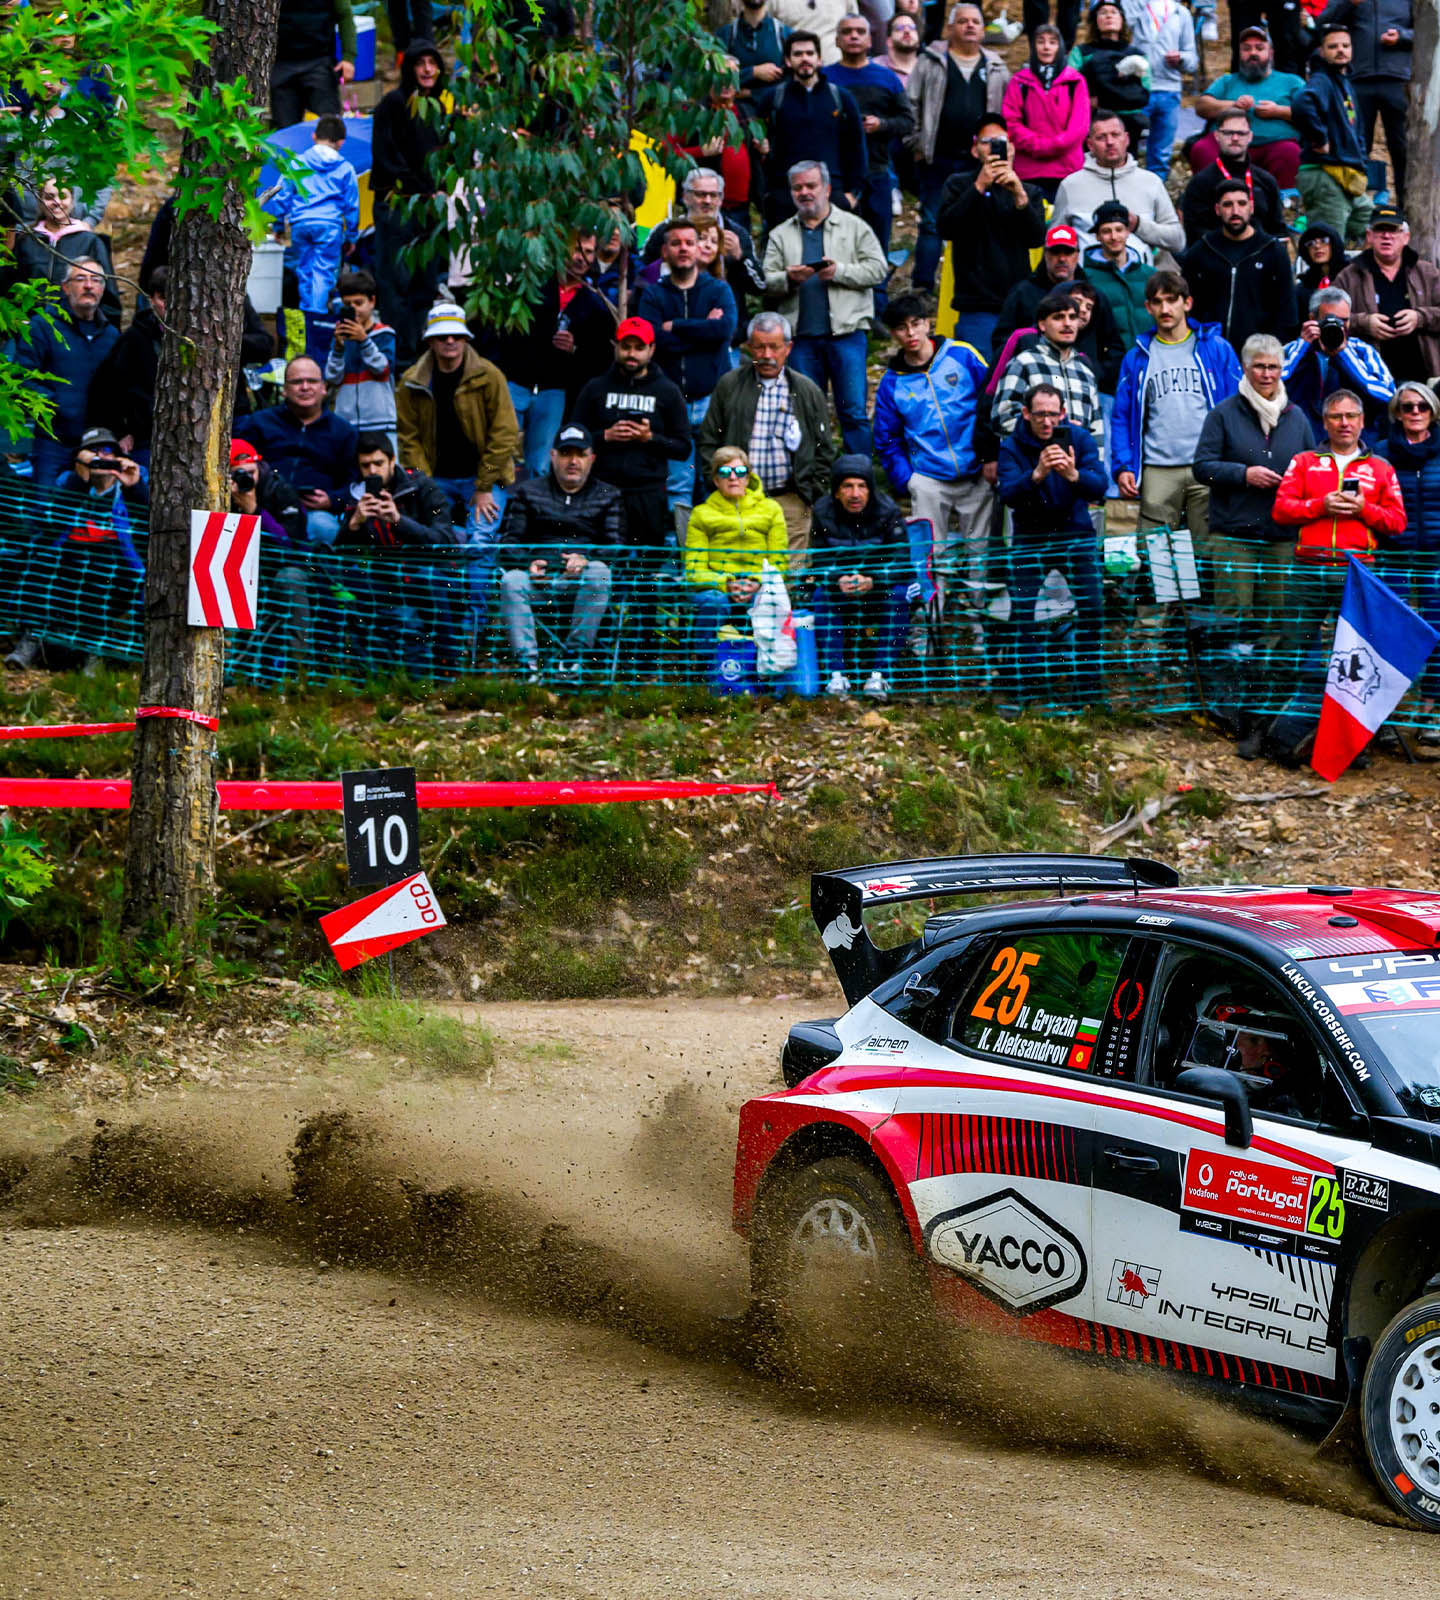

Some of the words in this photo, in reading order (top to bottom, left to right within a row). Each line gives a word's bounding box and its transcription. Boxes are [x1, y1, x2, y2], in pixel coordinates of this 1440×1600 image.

[605, 392, 657, 413] PUMA
[1147, 367, 1201, 404] DICKIE
[358, 814, 409, 867] 10
[971, 946, 1041, 1026] 25
[1015, 1006, 1028, 1030] N.
[1032, 1009, 1078, 1038] Gryazin
[1280, 962, 1372, 1082] LANCIA-CORSEHF.COM
[868, 1035, 909, 1050] aichem
[978, 1027, 990, 1050] K.
[995, 1028, 1069, 1066] Aleksandrov
[1188, 1186, 1219, 1201] vodafone
[1226, 1178, 1304, 1209] Portugal
[1229, 1169, 1247, 1181] rally
[1247, 1173, 1258, 1181] de
[1195, 1218, 1223, 1232] WRC2
[1287, 1214, 1303, 1225] 2026
[1307, 1177, 1346, 1239] 25
[955, 1230, 1066, 1279] YACCO
[1211, 1282, 1329, 1325] YPSILON
[1158, 1299, 1327, 1355] INTEGRALE
